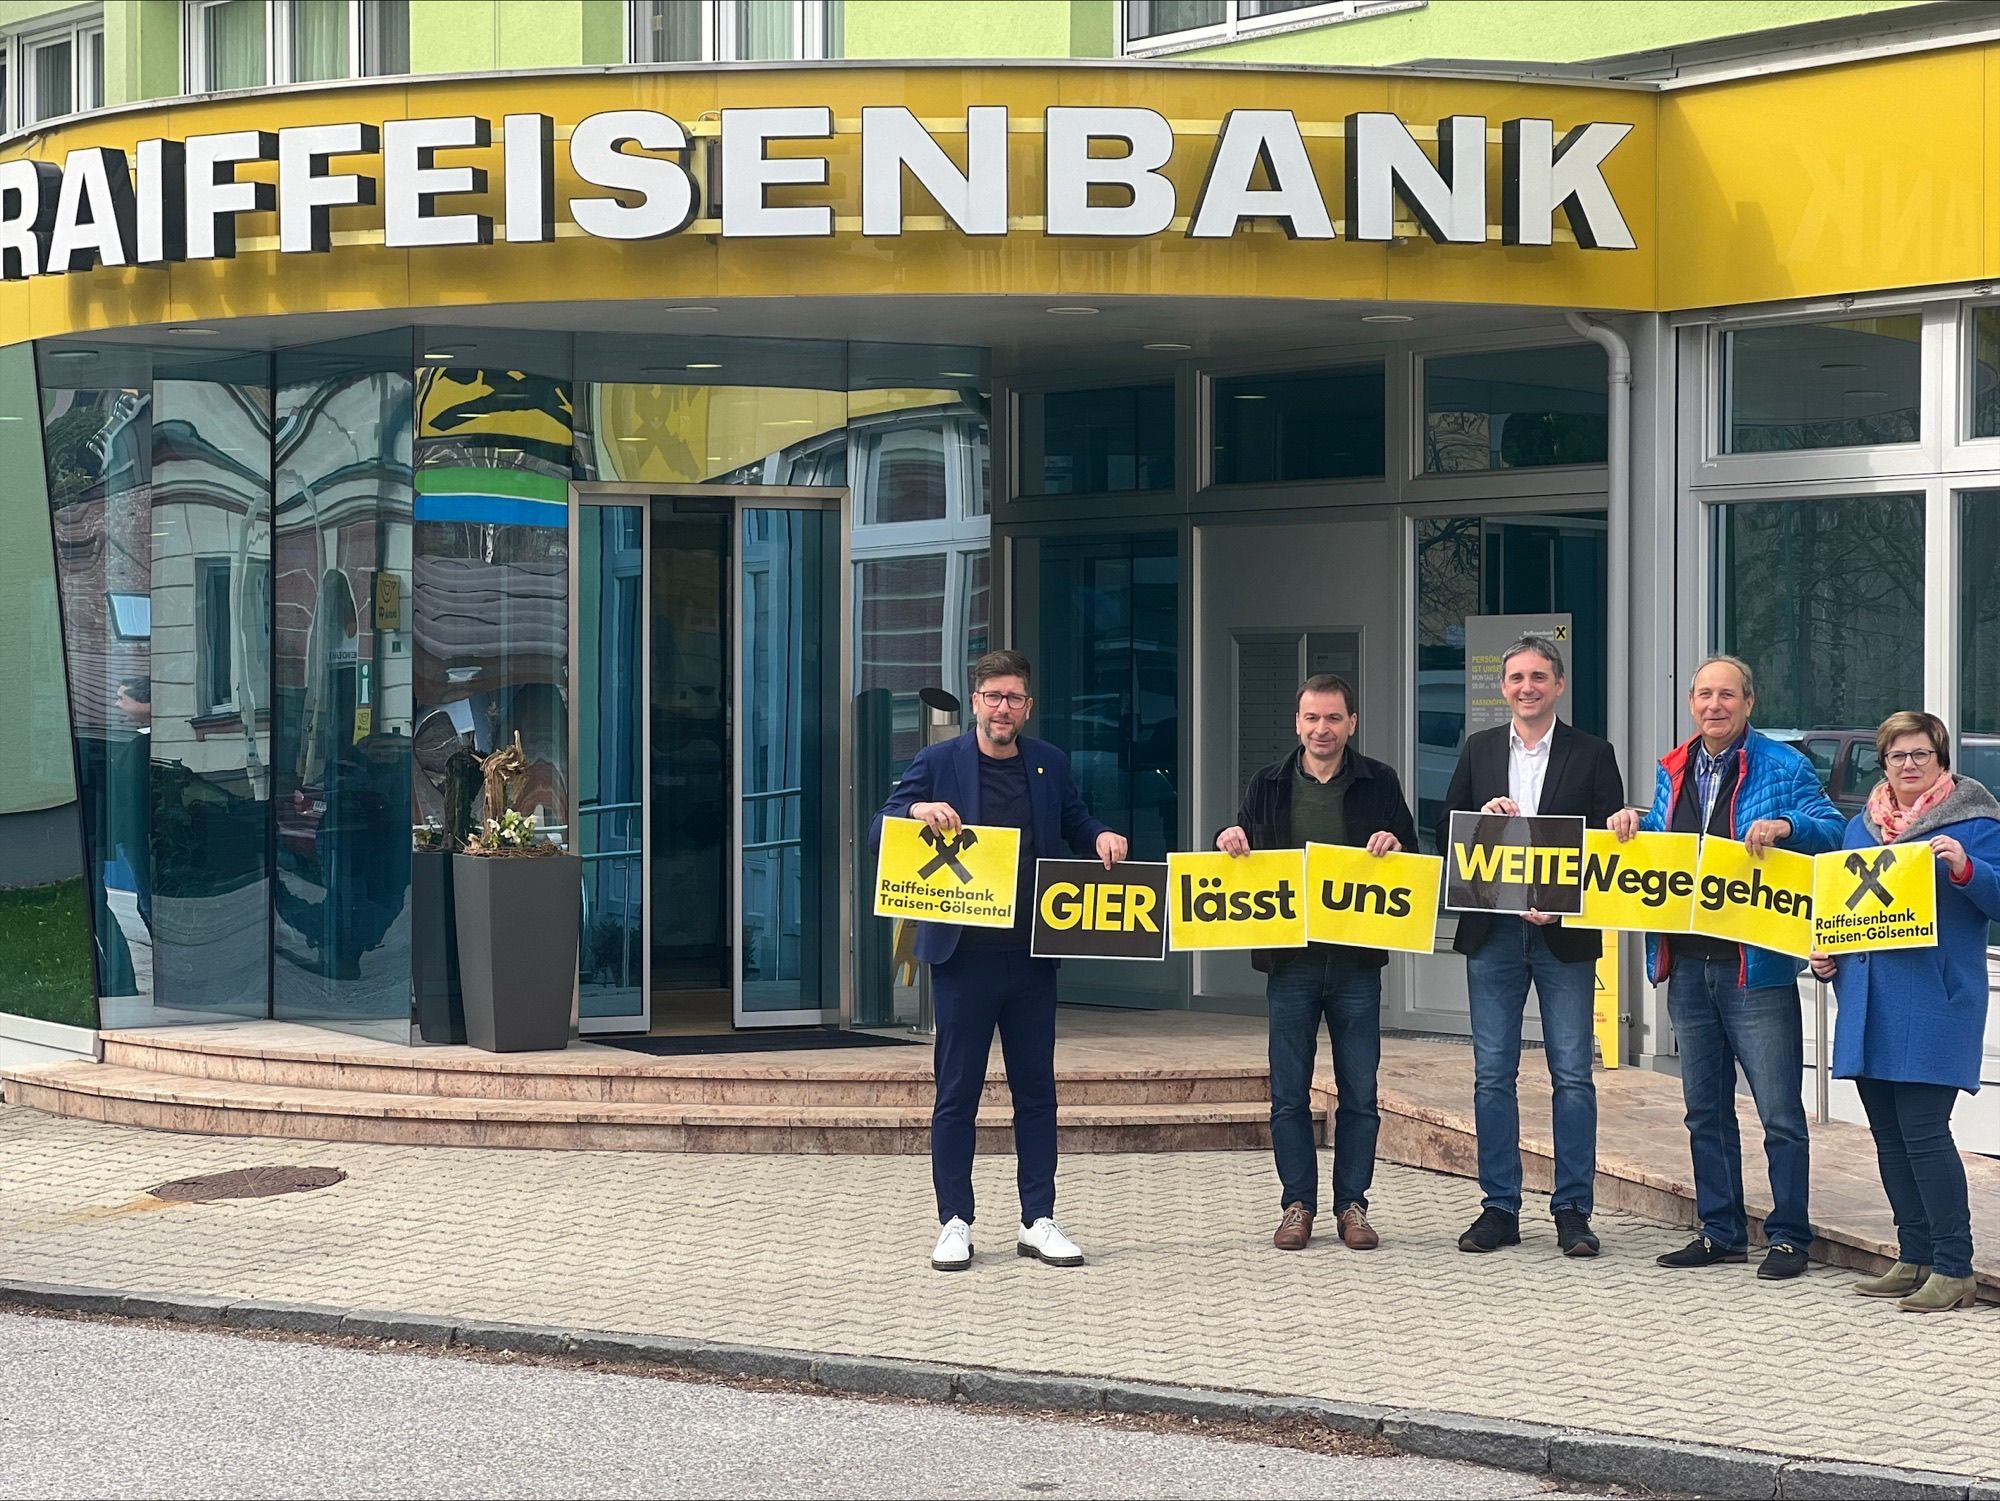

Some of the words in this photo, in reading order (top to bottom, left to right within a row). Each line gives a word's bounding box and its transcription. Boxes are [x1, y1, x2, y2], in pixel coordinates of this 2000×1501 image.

[0, 104, 1638, 281] RAIFFEISENBANK
[880, 879, 994, 902] Raiffeisenbank
[1040, 881, 1160, 933] GIER
[1181, 874, 1297, 922] lässt
[1321, 879, 1412, 918] uns
[1453, 842, 1580, 886] WEITE
[1699, 868, 1813, 921] gehen
[879, 893, 1012, 918] Traisen-Gölsental
[1815, 908, 1916, 931] Raiffeisenbank
[1815, 922, 1934, 946] Traisen-Gölsental
